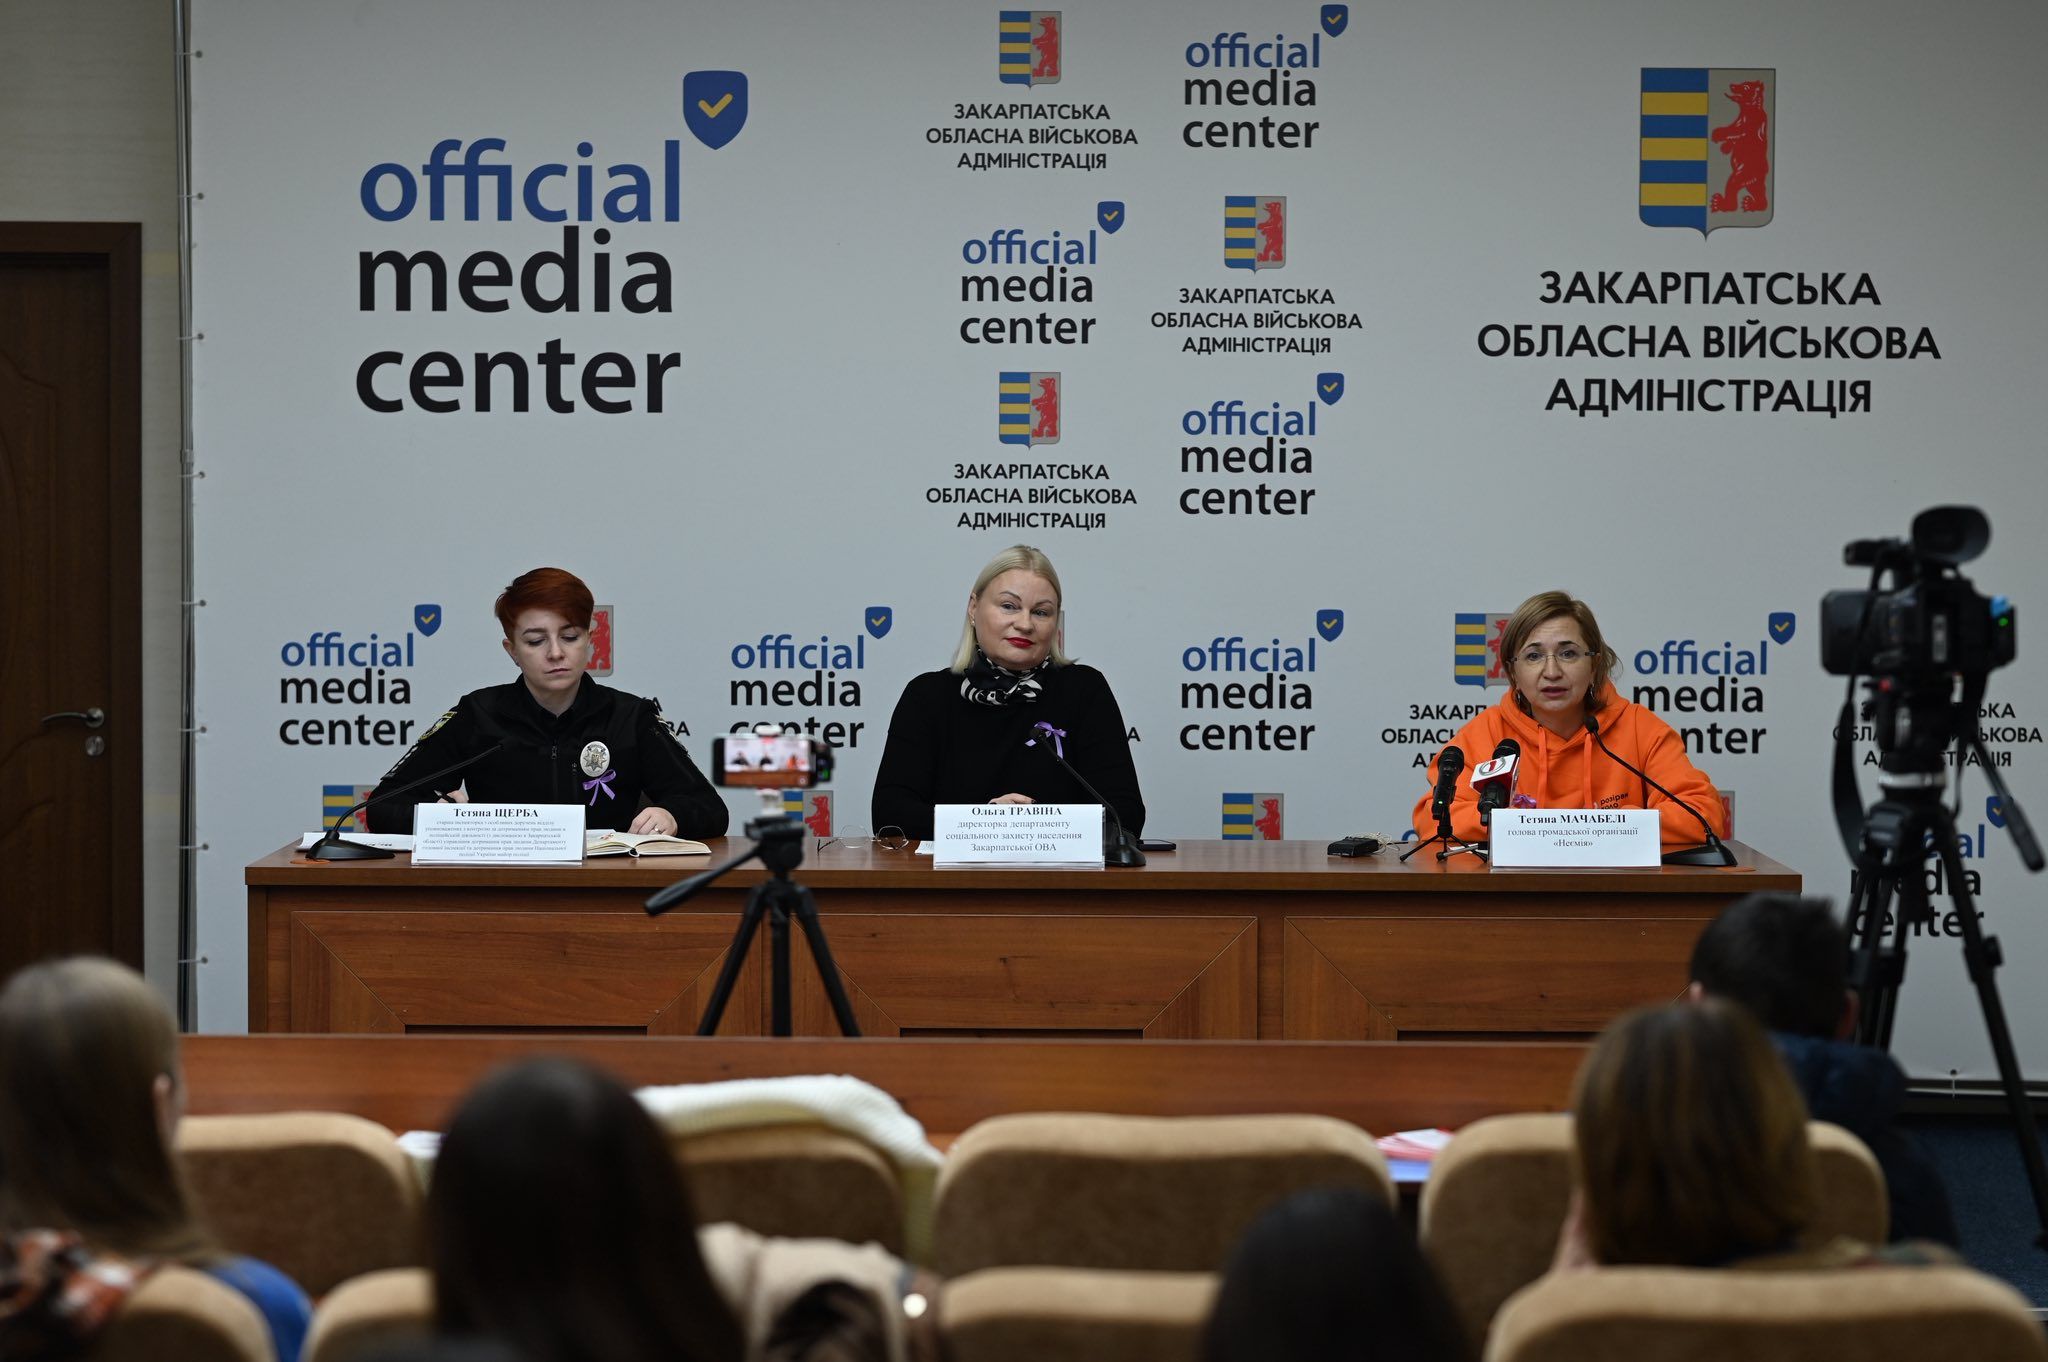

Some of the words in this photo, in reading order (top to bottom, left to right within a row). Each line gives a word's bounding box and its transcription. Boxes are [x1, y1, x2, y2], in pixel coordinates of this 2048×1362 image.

[1185, 31, 1320, 69] official
[1184, 68, 1316, 107] media
[954, 103, 1111, 120] ЗАКАРПАТСЬКА
[926, 127, 1024, 144] ОБЛАСНА
[1029, 125, 1139, 145] ВІЙСЬКОВА
[1182, 115, 1320, 149] center
[957, 152, 1107, 172] АДМІНІСТРАЦІЯ
[360, 137, 680, 224] official
[962, 228, 1097, 266] official
[359, 225, 673, 314] media
[961, 265, 1093, 303] media
[1179, 287, 1336, 305] ЗАКАРПАТСЬКА
[1539, 270, 1882, 306] ЗАКАРПАТСЬКА
[960, 312, 1097, 345] center
[1150, 312, 1249, 329] ОБЛАСНА
[1253, 310, 1363, 329] ВІЙСЬКОВА
[1181, 336, 1331, 356] АДМІНІСТРАЦІЯ
[1477, 323, 1691, 358] ОБЛАСНА
[1703, 318, 1942, 360] ВІЙСЬКОВА
[356, 338, 681, 415] center
[1544, 378, 1872, 419] АДМІНІСТРАЦІЯ
[1182, 400, 1316, 437] official
[954, 463, 1110, 480] ЗАКАРПАТСЬКА
[1181, 436, 1312, 474] media
[926, 487, 1024, 504] ОБЛАСНА
[1028, 485, 1137, 505] ВІЙСЬКОВА
[1179, 483, 1316, 516] center
[957, 512, 1106, 532] АДМІНІСТРАЦІЯ
[281, 631, 414, 668] official
[731, 633, 864, 671] official
[1182, 636, 1316, 674] official
[1634, 639, 1768, 676] official
[280, 667, 411, 705] media
[730, 667, 861, 707] media
[1181, 672, 1312, 710] media
[1633, 675, 1764, 712] media
[279, 712, 415, 746] center
[1179, 719, 1316, 751] center
[1381, 728, 1456, 744] ОБЛАС
[1680, 722, 1767, 754] nter
[454, 807, 492, 818] Тетяна
[495, 808, 539, 818] ЩЕРБА
[957, 821, 1008, 829] директорка
[1010, 821, 1070, 829] департаменту
[972, 807, 1005, 816] Ольга
[1008, 807, 1062, 816] ТРАВІНА
[1518, 814, 1556, 824] Тетяна
[1560, 813, 1626, 824] МАЧАБЕЛІ
[945, 832, 999, 840] соціального
[1001, 832, 1034, 840] захисту
[1037, 832, 1082, 840] населення
[971, 843, 1032, 852] Закарпатської
[1034, 843, 1057, 852] ОВА
[1507, 828, 1536, 836] голова
[1538, 828, 1590, 837] громадської
[1591, 827, 1638, 837] організації
